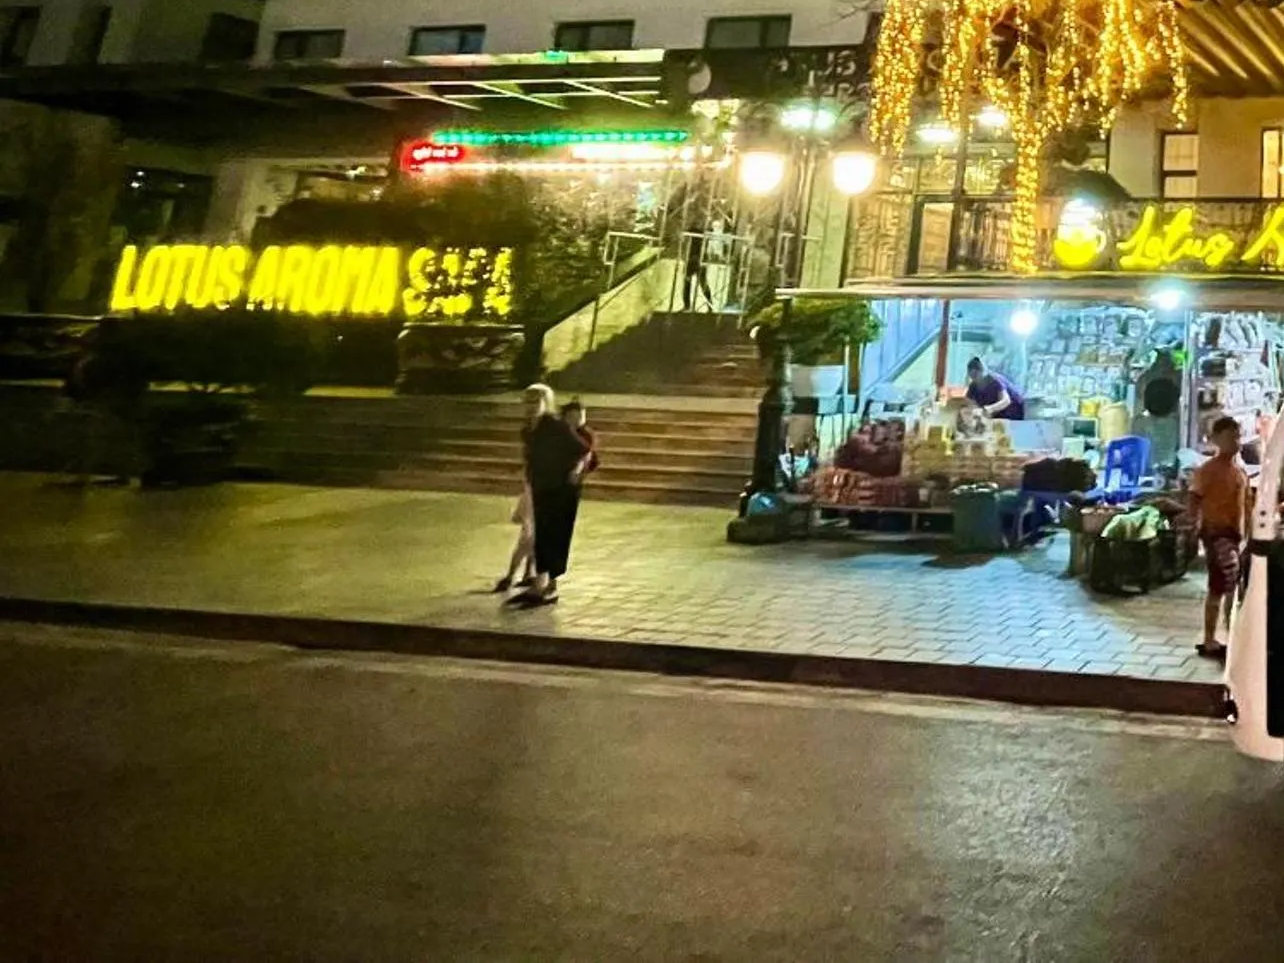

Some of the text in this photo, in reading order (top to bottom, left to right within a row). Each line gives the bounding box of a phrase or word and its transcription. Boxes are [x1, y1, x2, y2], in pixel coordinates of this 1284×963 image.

[1117, 205, 1234, 269] Lotus
[111, 245, 247, 310] LOTUS
[247, 244, 399, 315] AROMA
